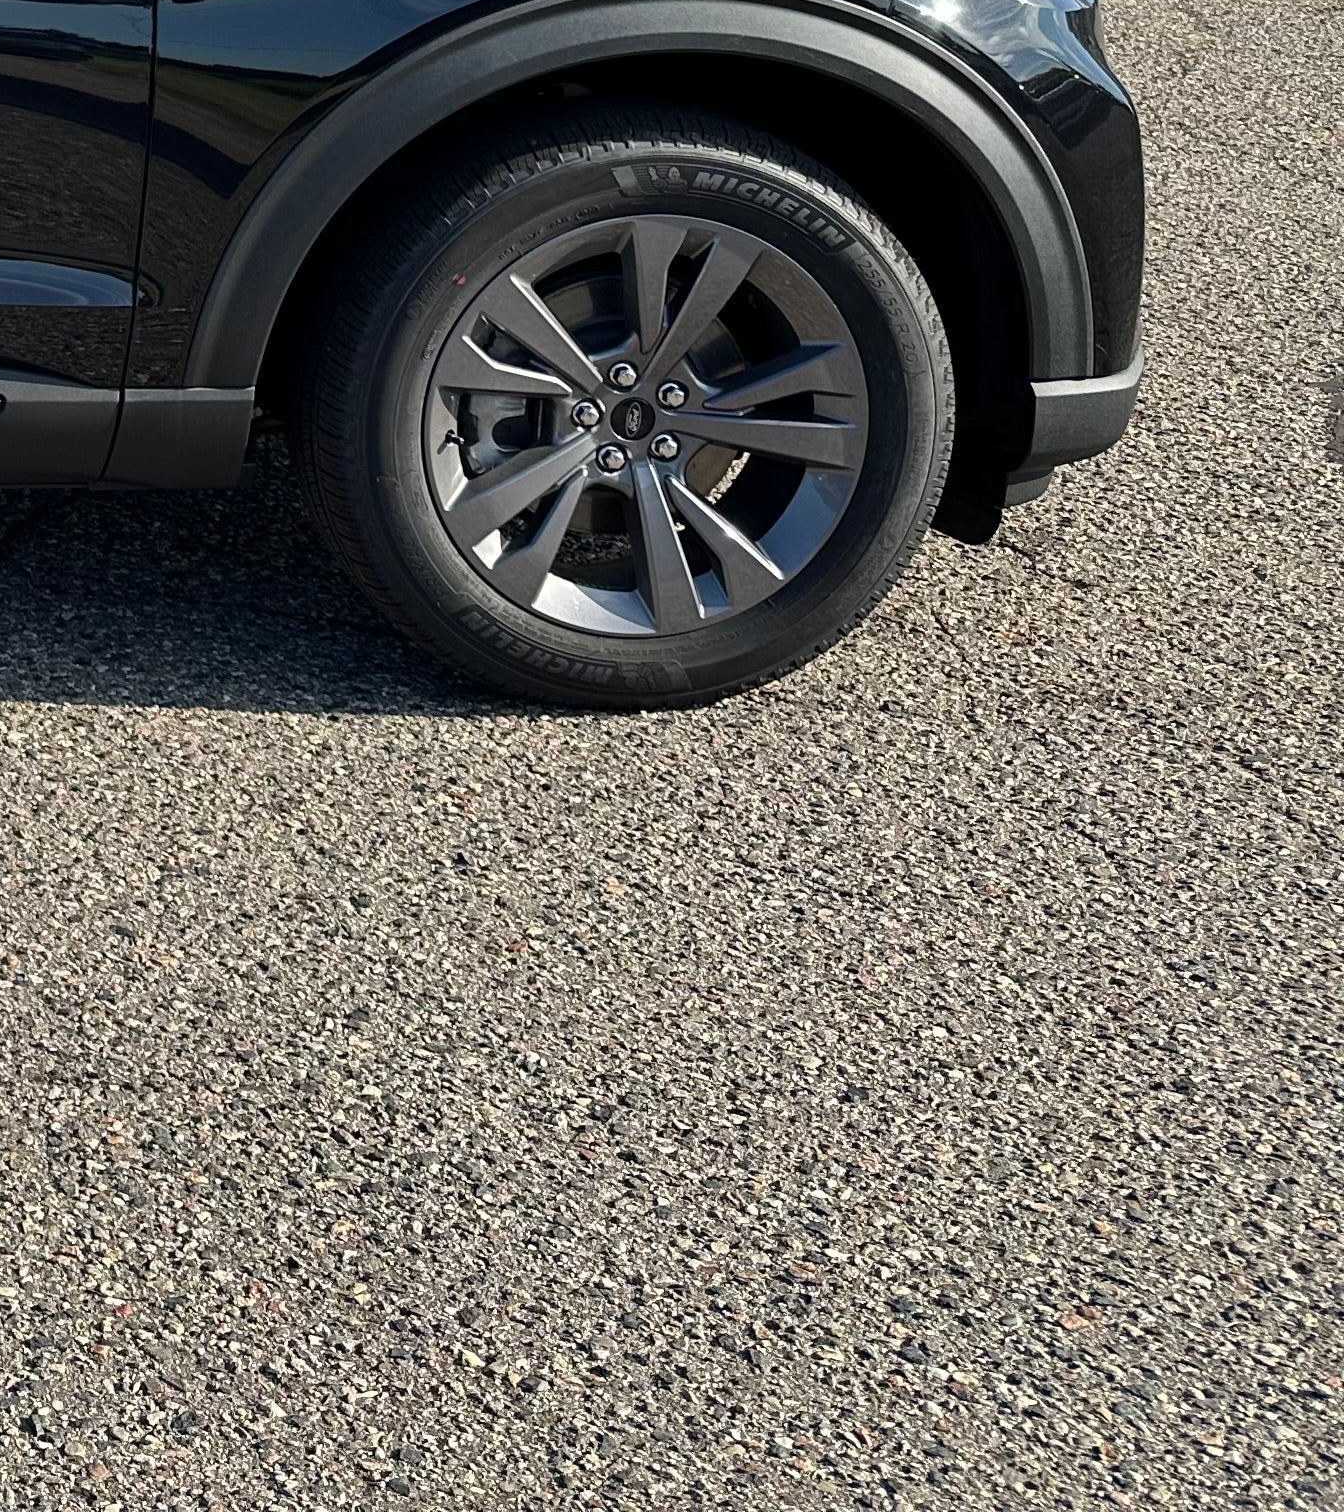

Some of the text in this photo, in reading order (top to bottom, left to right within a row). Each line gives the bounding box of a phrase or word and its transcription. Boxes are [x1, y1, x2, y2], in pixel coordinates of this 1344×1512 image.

[694, 171, 847, 249] MICHELIN
[856, 254, 904, 319] 255/55
[894, 323, 912, 338] R
[462, 610, 615, 686] MICHELIN
